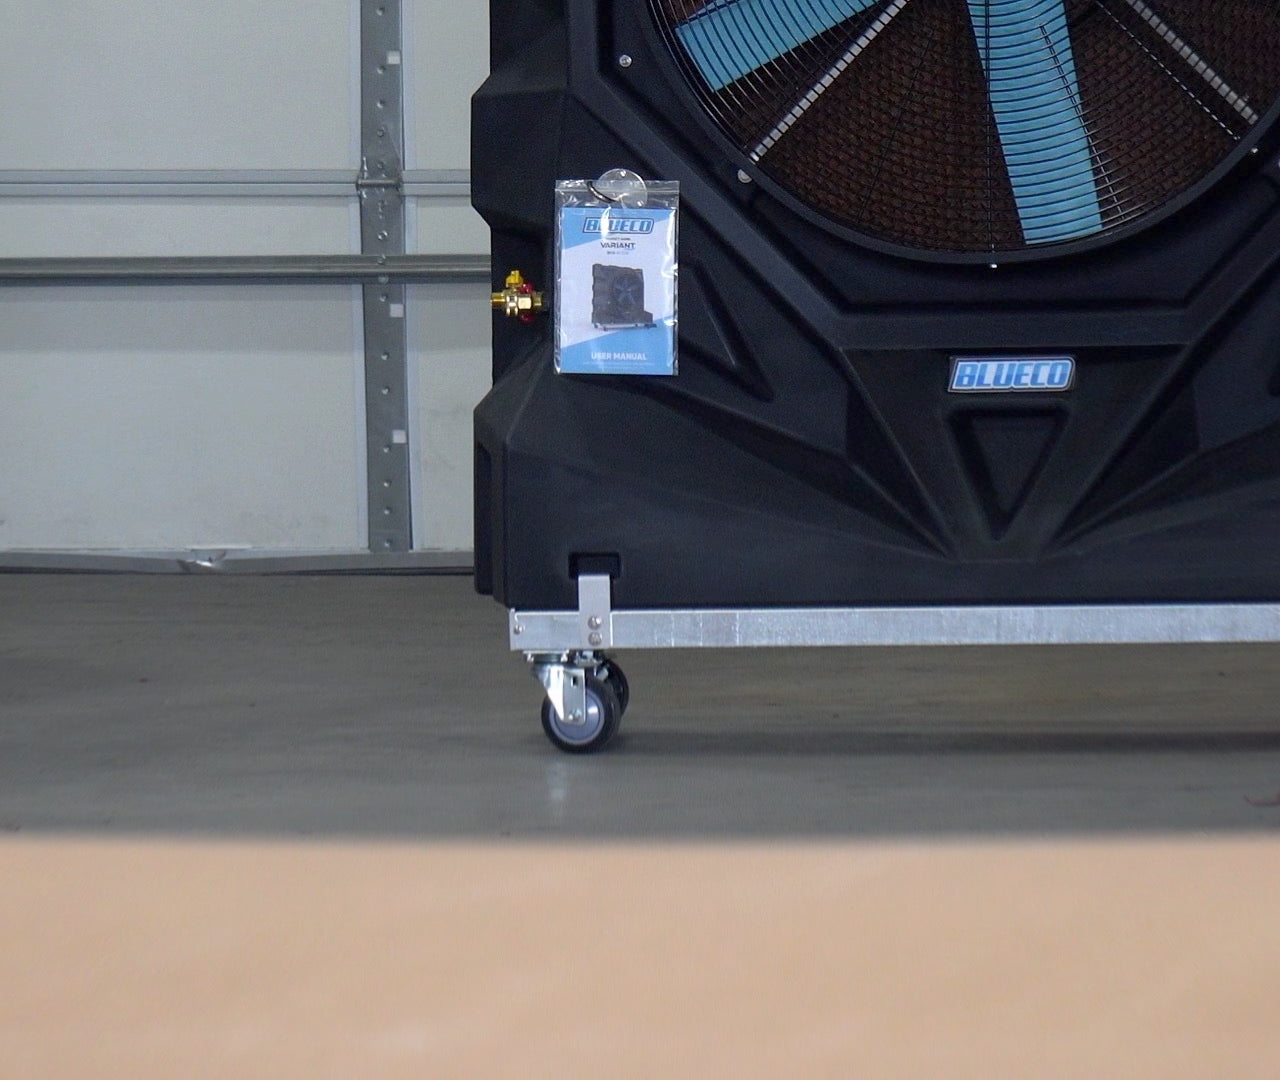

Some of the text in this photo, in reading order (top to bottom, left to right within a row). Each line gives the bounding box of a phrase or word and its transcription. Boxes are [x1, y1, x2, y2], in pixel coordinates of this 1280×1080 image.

[585, 218, 653, 233] BUECO
[591, 352, 647, 360] USER MANUAL
[954, 361, 1072, 388] BLUECO
